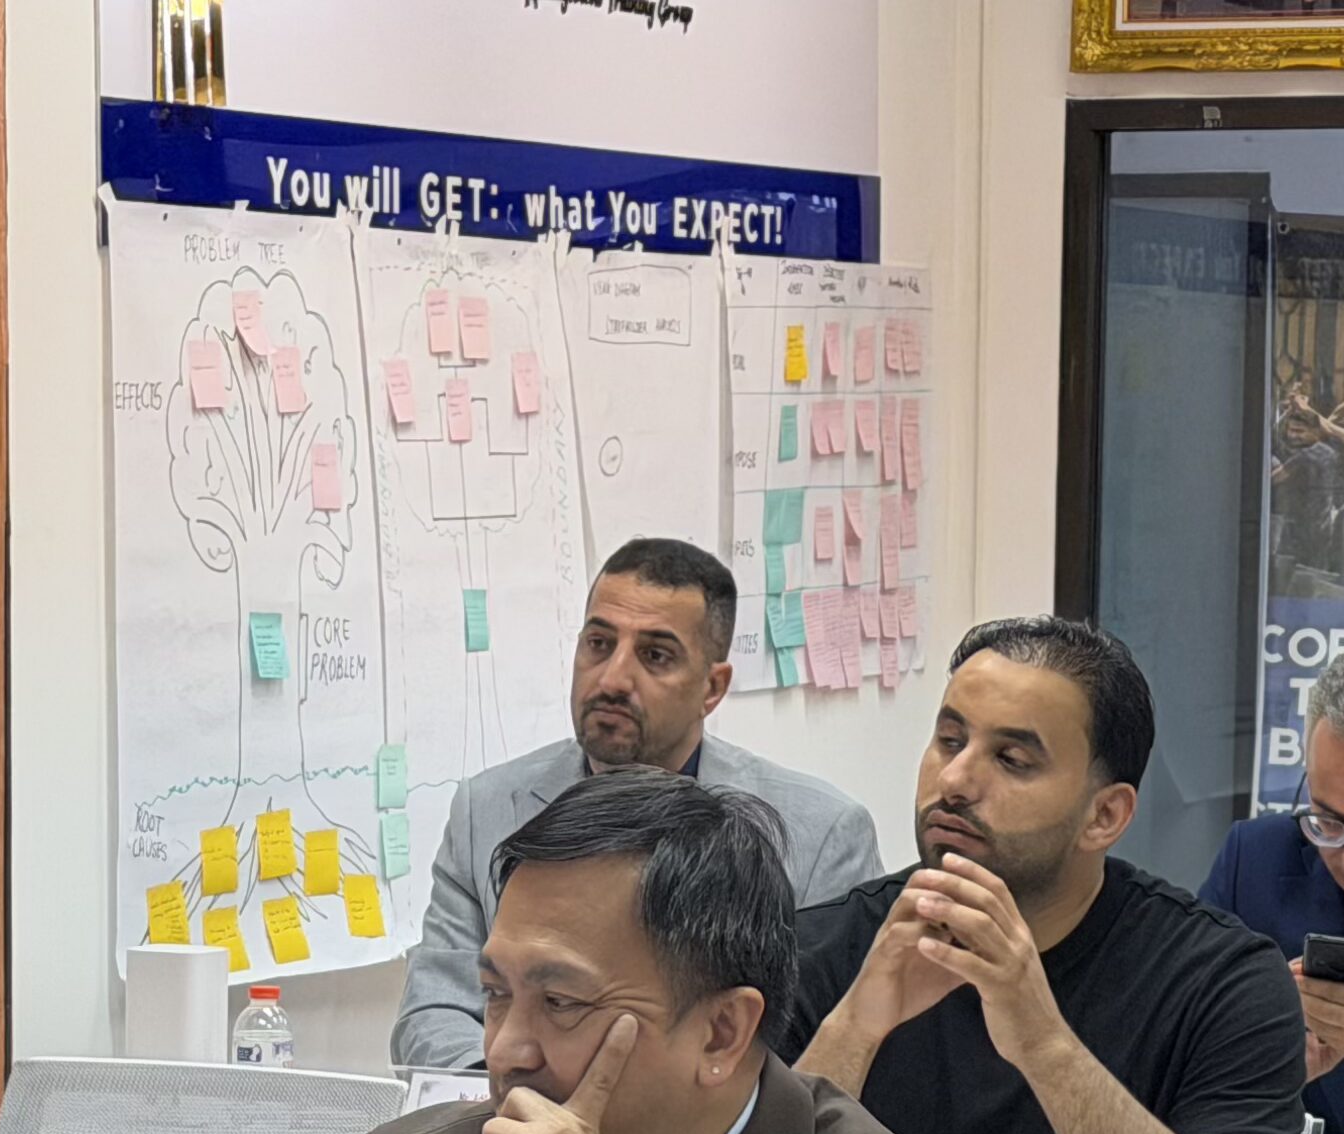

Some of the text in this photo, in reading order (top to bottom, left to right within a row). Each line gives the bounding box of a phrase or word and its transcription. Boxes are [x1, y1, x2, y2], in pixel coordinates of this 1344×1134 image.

[266, 156, 783, 244] You will GET: what You EXPECT!
[184, 234, 286, 264] PROBLEM TREE
[115, 381, 163, 412] EFFECTS
[313, 616, 351, 648] CORE
[310, 652, 366, 686] PROBLEM
[135, 807, 165, 837] ROOT
[132, 841, 167, 862] CAUSES
